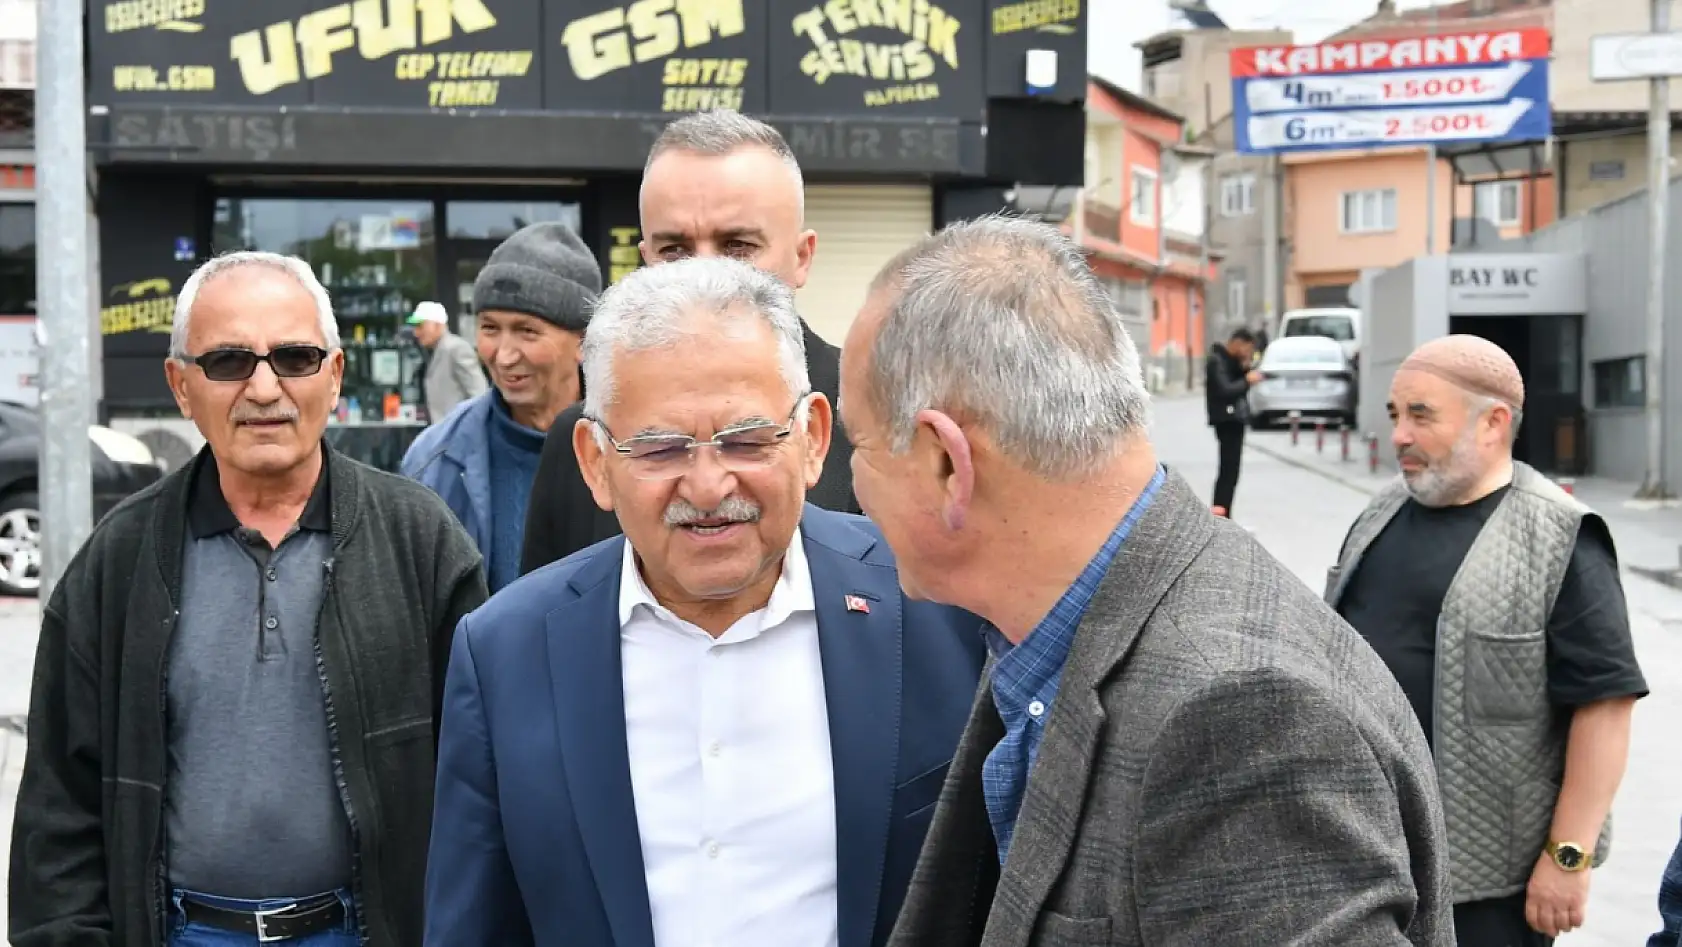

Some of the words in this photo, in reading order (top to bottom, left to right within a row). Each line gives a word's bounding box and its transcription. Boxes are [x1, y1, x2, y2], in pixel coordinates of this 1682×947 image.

[230, 0, 497, 94] UFUK
[561, 0, 745, 80] GSM
[1255, 31, 1522, 74] KAMPANYA
[396, 54, 435, 79] CEP
[1450, 267, 1496, 287] BAY
[1502, 267, 1539, 287] WC
